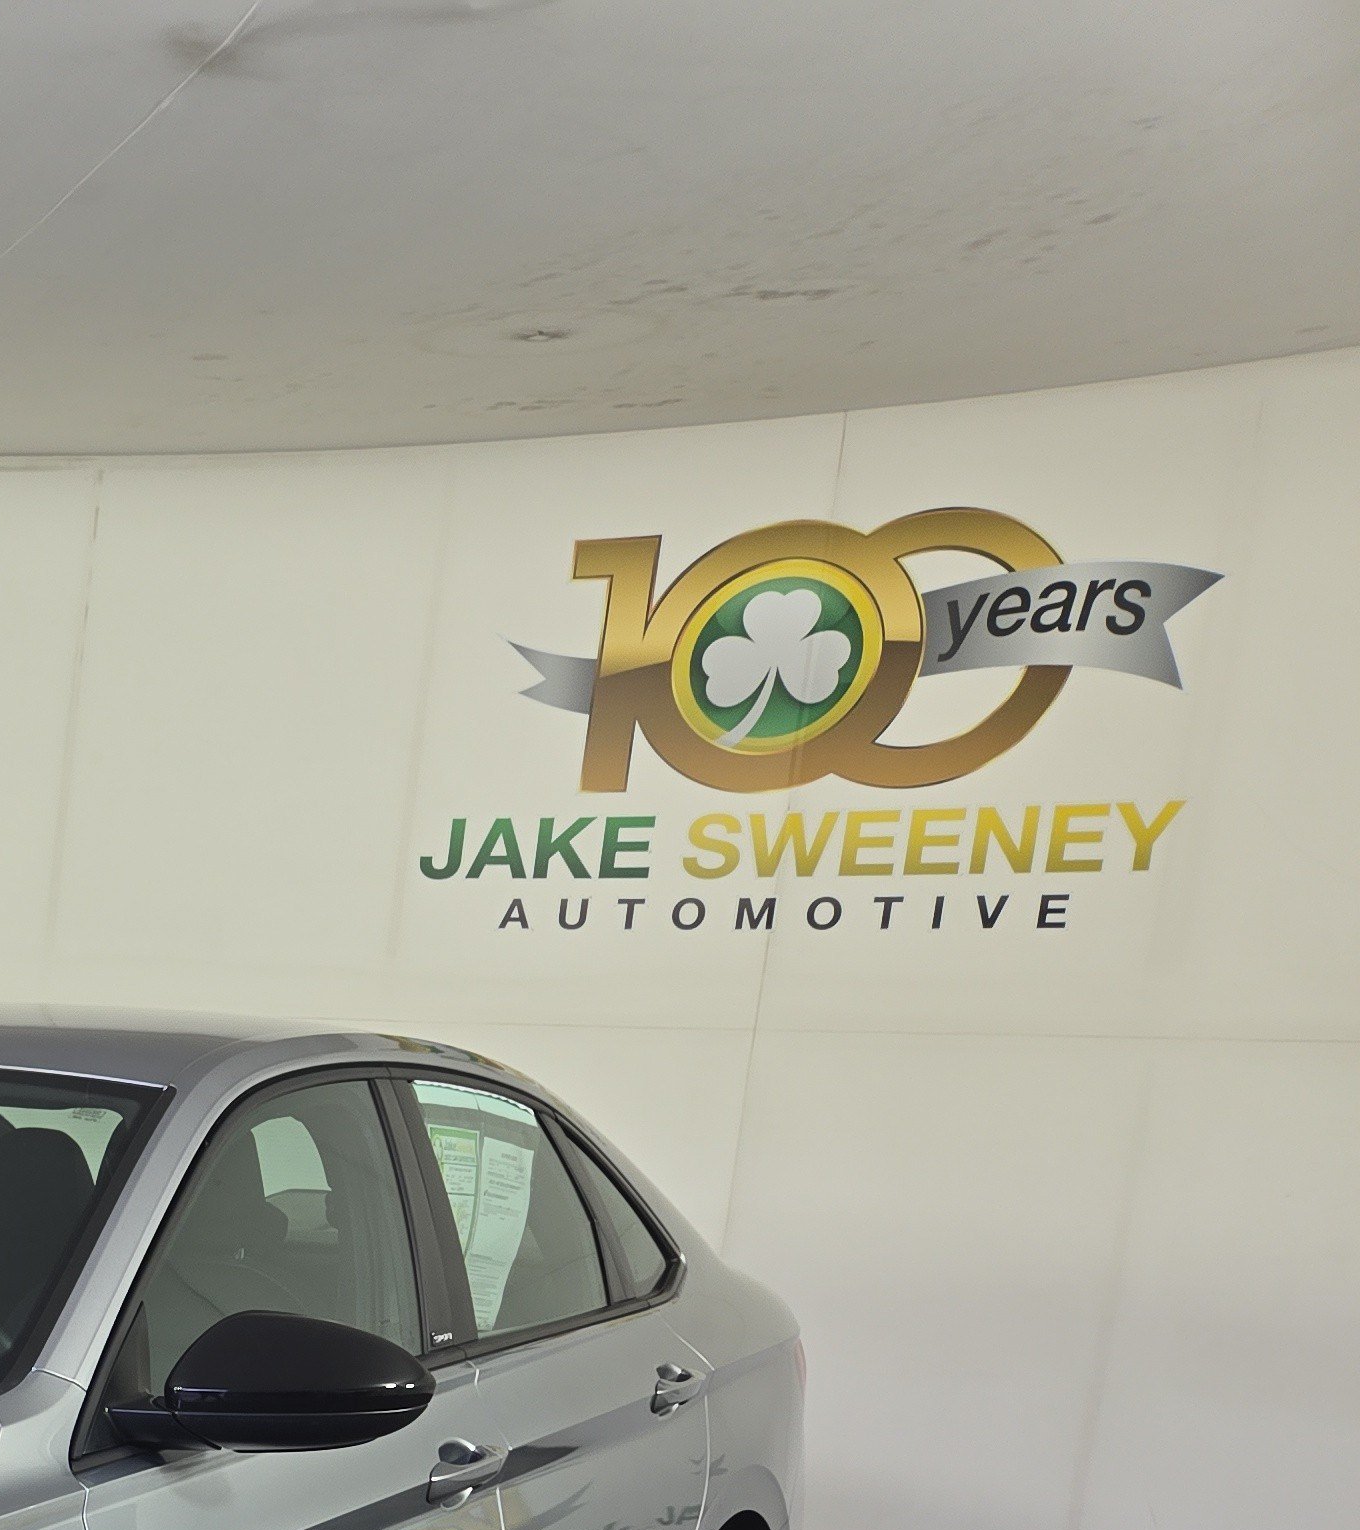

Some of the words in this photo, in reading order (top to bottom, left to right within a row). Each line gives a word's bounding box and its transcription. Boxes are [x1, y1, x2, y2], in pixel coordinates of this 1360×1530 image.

[571, 506, 1074, 794] 100
[935, 575, 1152, 662] years
[419, 815, 656, 880] JAKE
[681, 800, 1186, 880] SWEENEY
[498, 893, 1070, 931] AUTOMOTIVE
